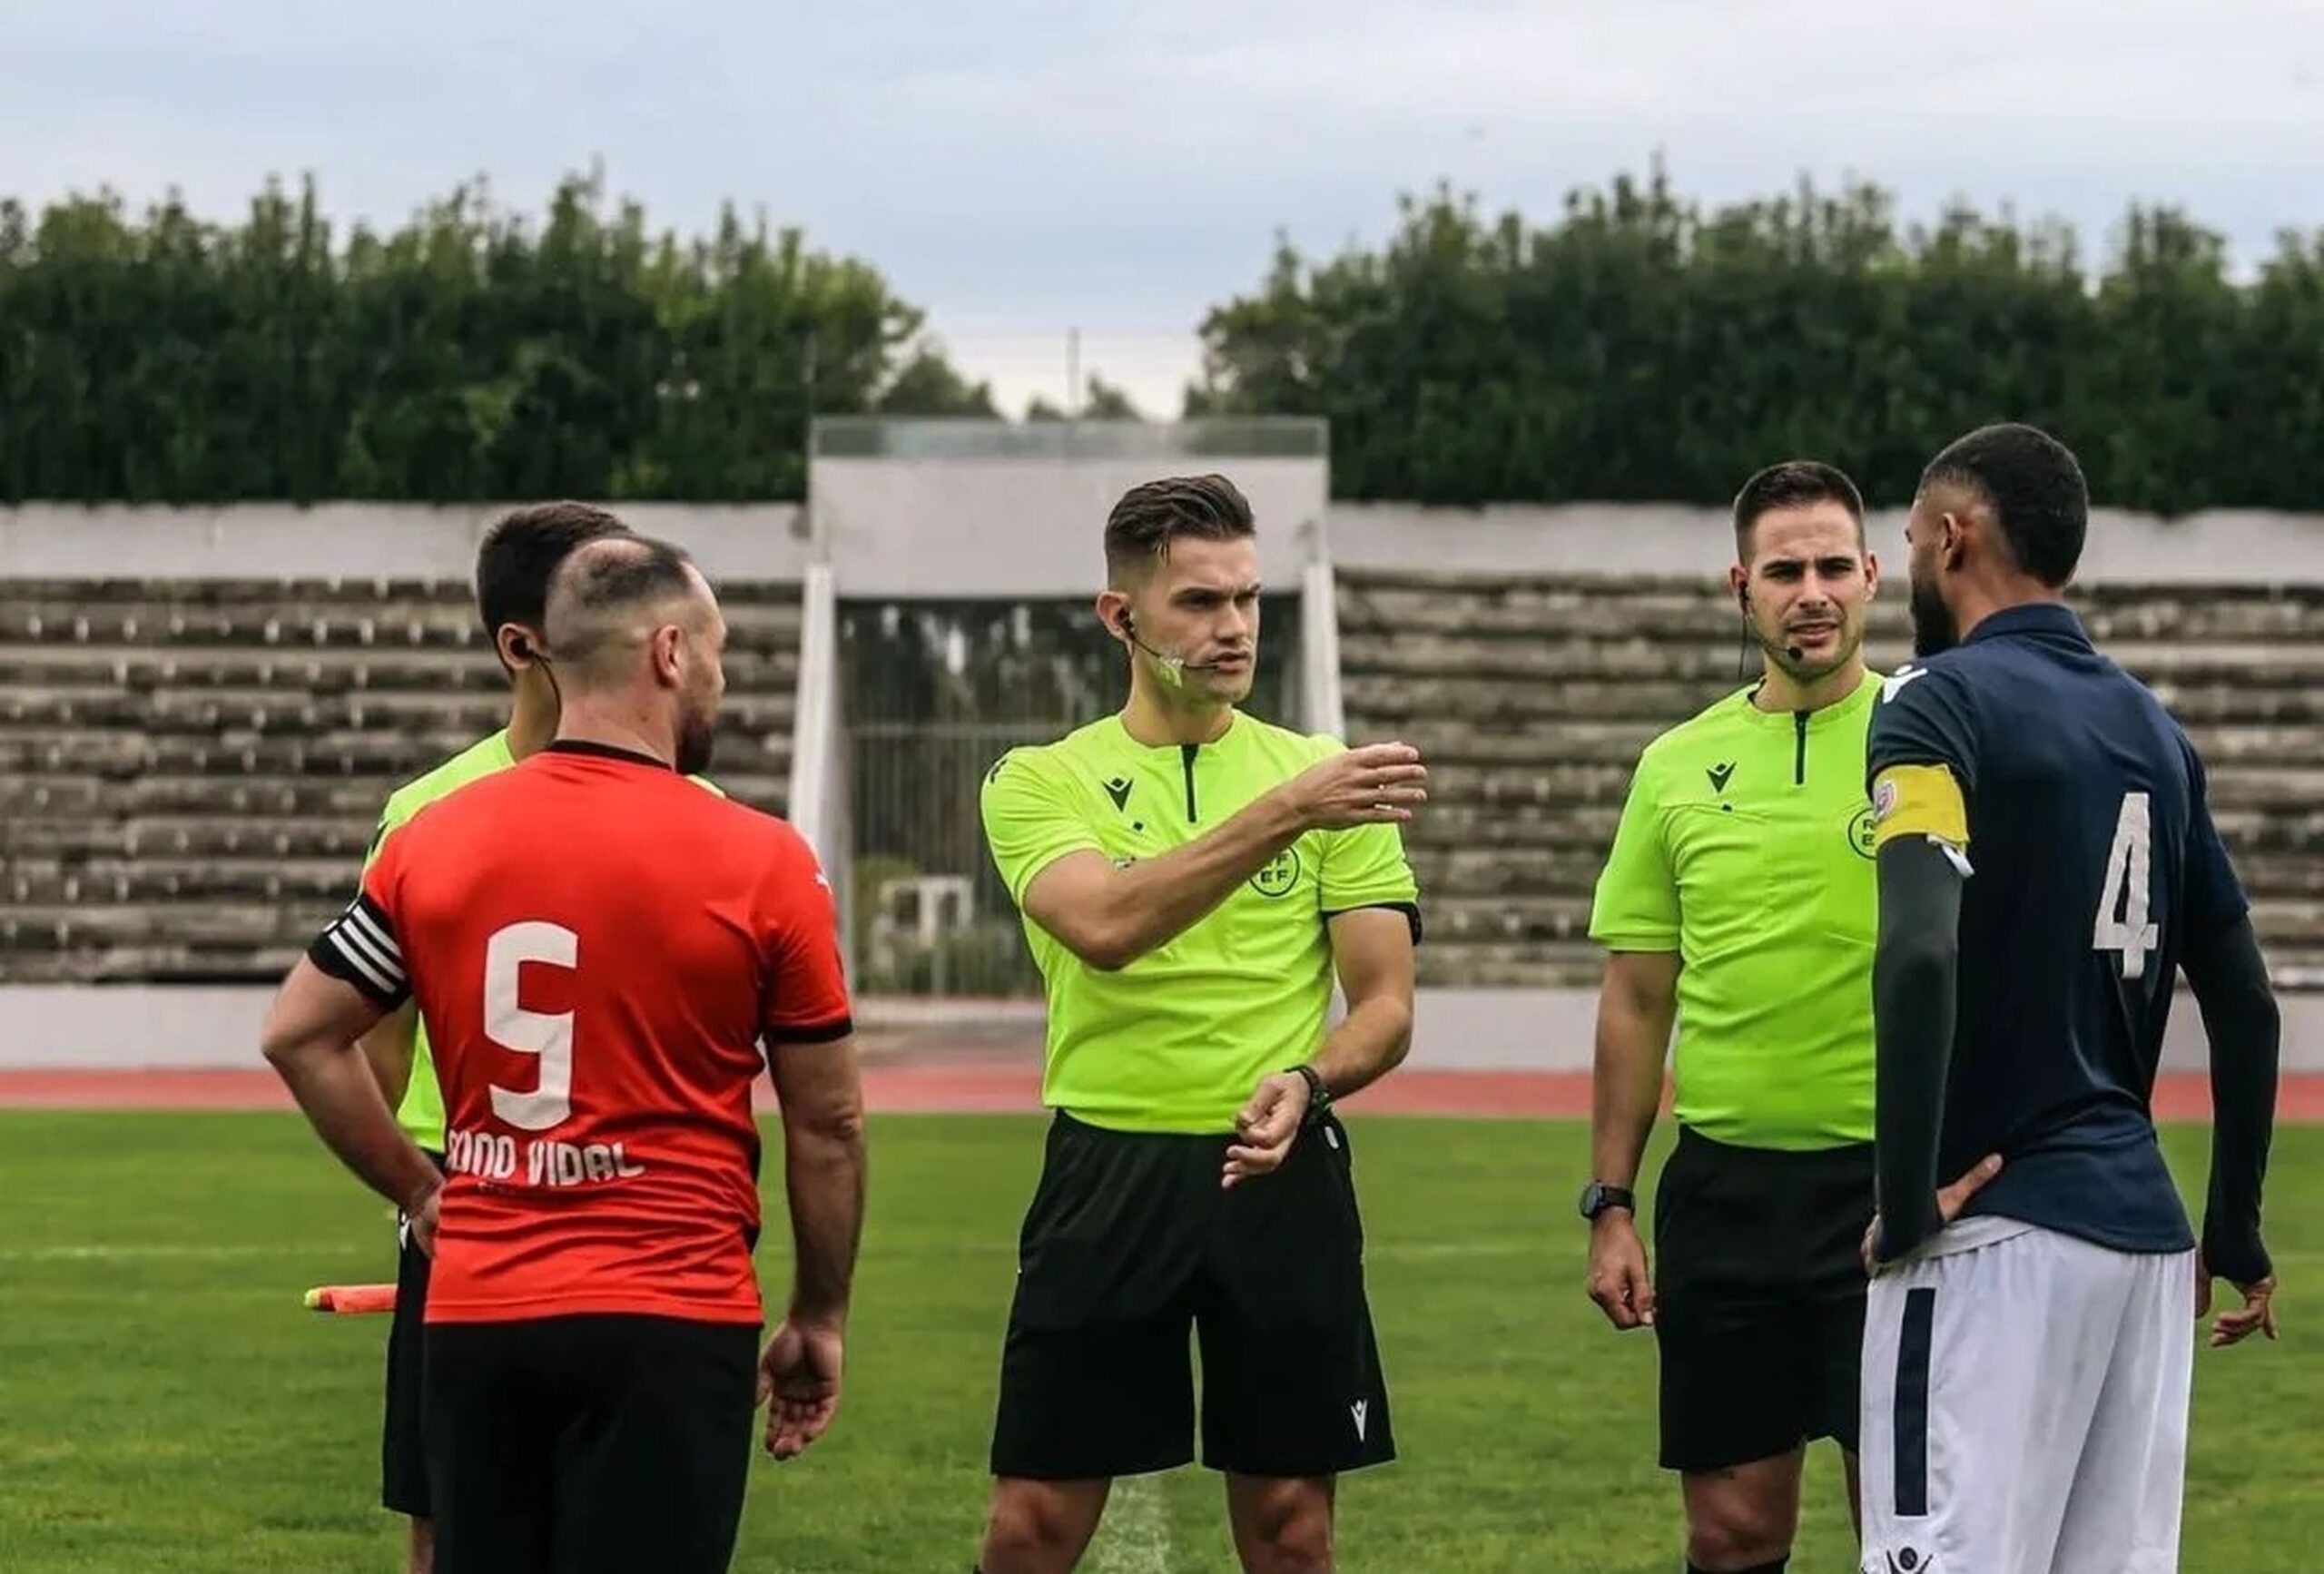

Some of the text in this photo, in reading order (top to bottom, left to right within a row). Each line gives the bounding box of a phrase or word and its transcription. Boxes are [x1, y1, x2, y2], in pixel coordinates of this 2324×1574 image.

[1260, 870, 1289, 883] EF
[2092, 792, 2159, 979] 4
[484, 920, 579, 1131] 5
[527, 1140, 645, 1187] VIDAL
